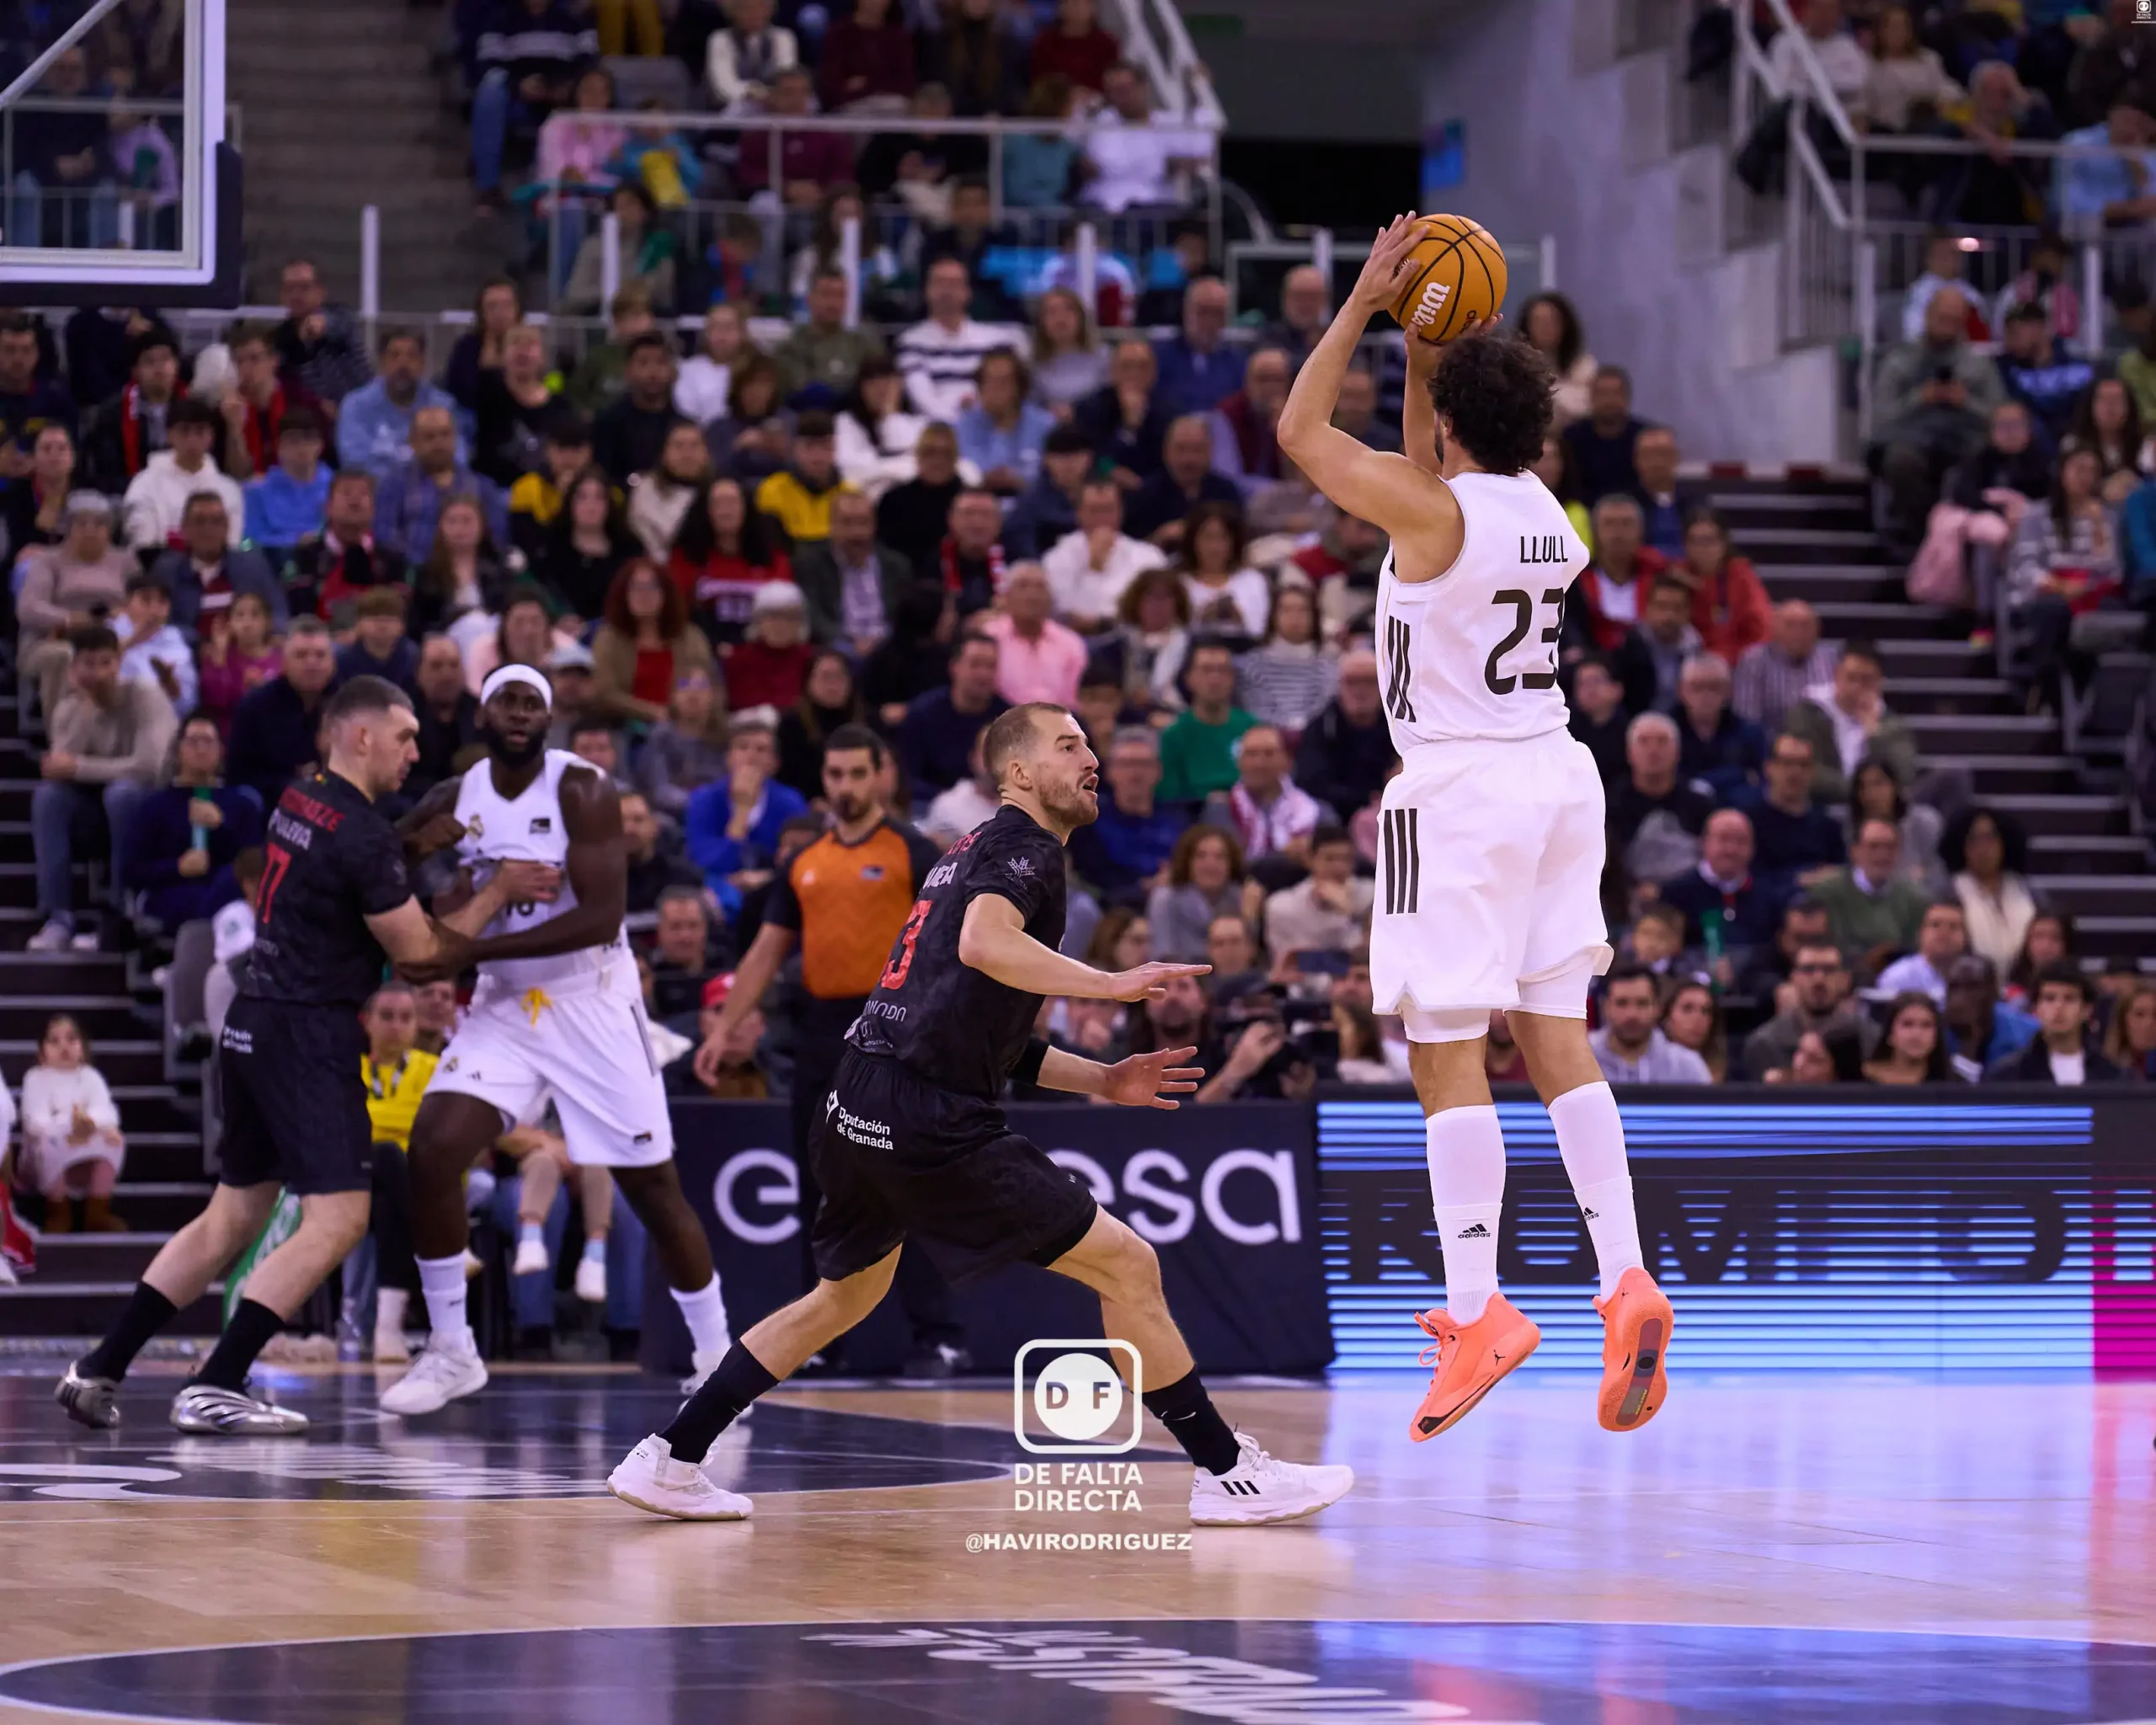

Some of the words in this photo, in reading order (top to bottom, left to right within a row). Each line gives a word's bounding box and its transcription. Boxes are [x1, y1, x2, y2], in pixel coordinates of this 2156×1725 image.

[1520, 536, 1568, 563] LLULL
[1484, 587, 1566, 695] 23
[256, 841, 292, 924] 77
[839, 1106, 891, 1135] Dputación
[836, 1122, 846, 1136] de
[847, 1127, 894, 1151] Granada
